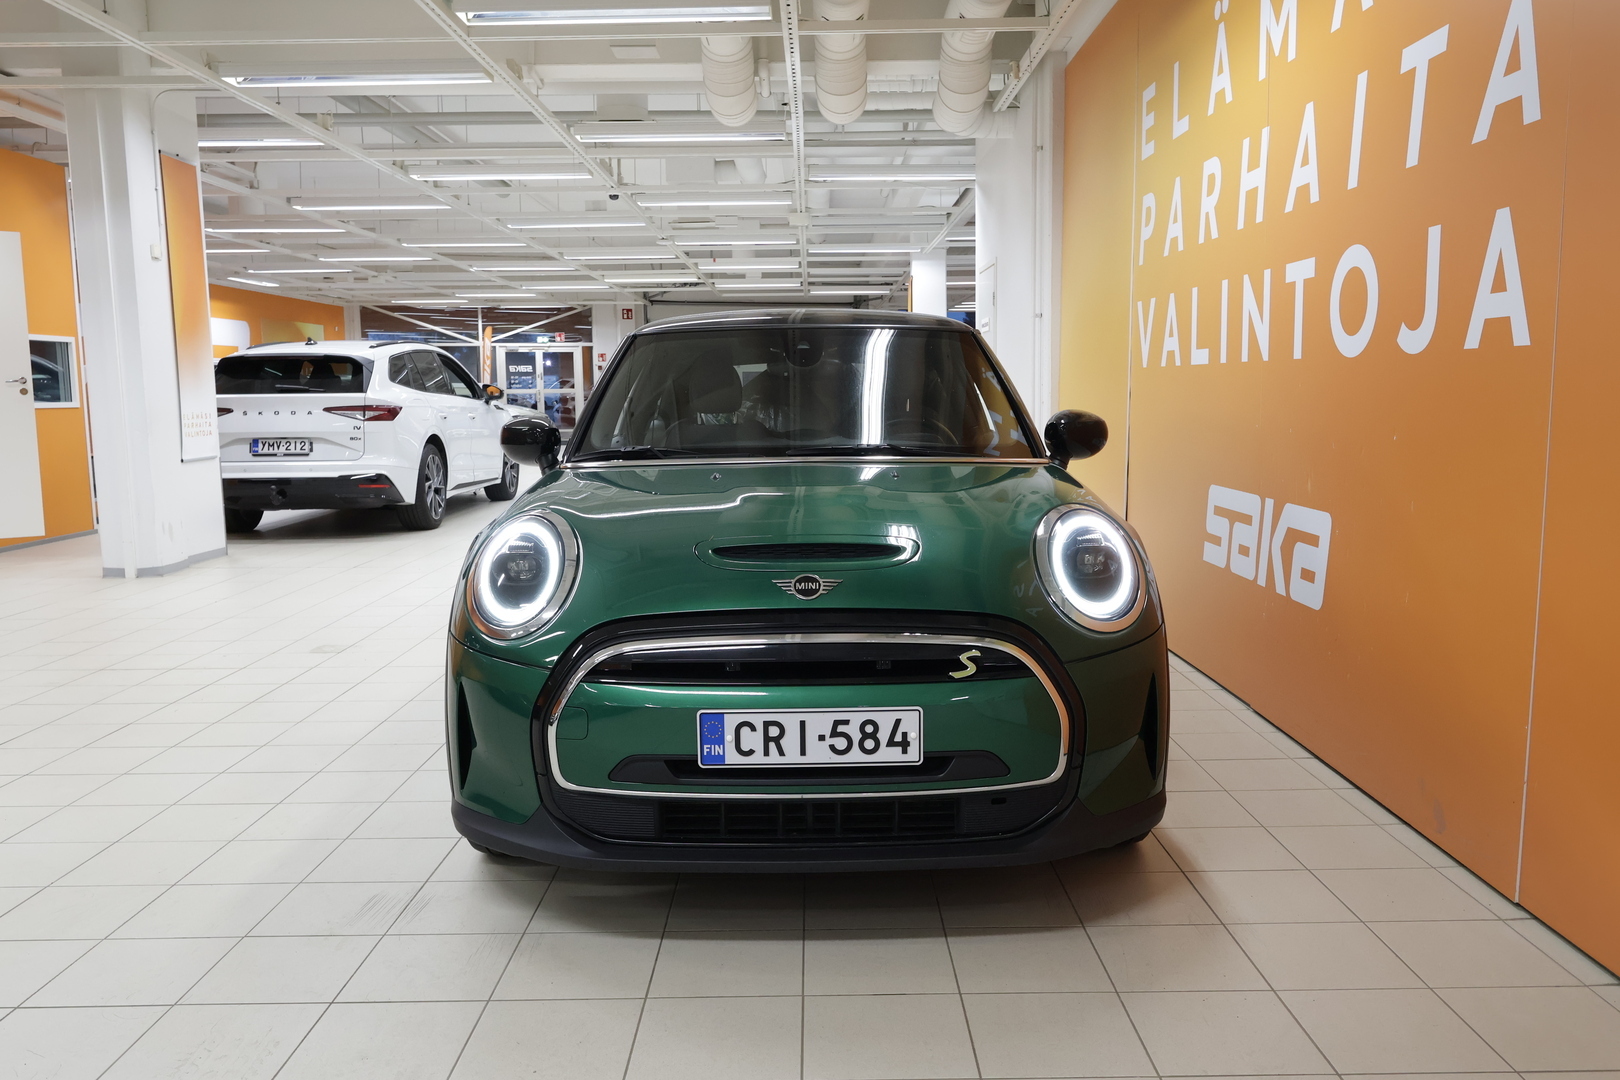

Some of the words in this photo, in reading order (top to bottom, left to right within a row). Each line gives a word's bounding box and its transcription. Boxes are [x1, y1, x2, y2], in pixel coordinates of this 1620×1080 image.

[1141, 0, 1374, 161] ELÄM
[1139, 0, 1542, 266] PARHAITA
[1137, 206, 1532, 368] VALINTOJA
[260, 440, 307, 452] YMV-212
[1202, 484, 1332, 611] saka
[795, 582, 819, 590] MINI
[948, 649, 981, 679] S
[704, 745, 723, 756] FIN
[733, 718, 911, 757] CRI-584
